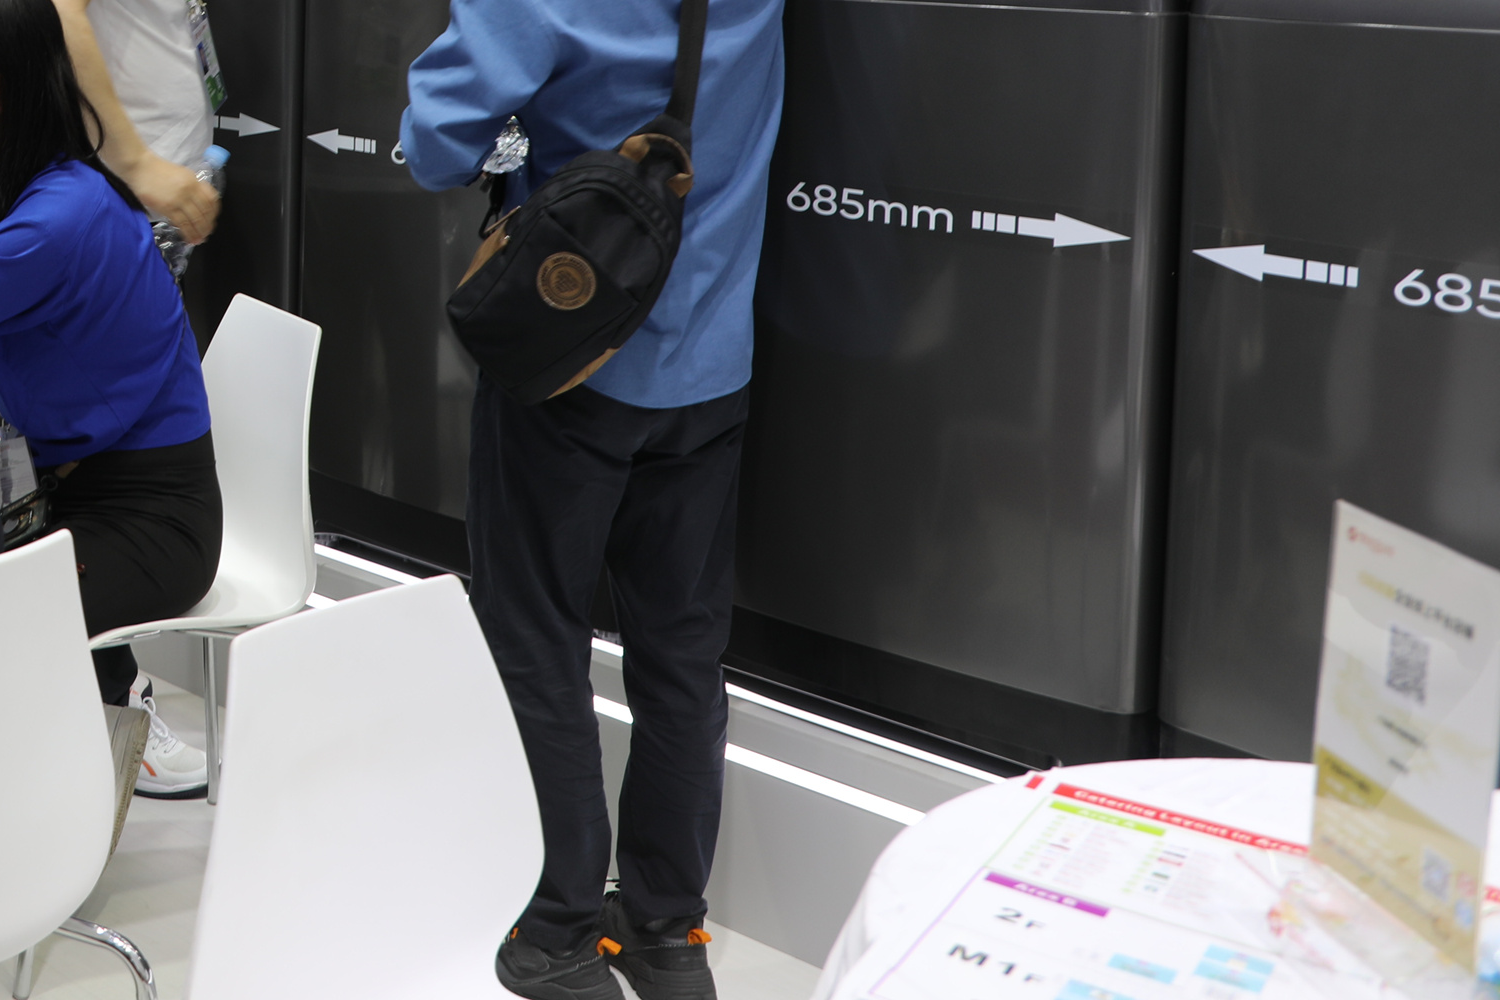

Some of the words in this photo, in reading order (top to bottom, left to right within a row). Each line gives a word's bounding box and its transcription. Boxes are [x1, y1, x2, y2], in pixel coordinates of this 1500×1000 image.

[786, 182, 953, 233] 685mm
[1394, 268, 1500, 319] 685
[1074, 790, 1158, 818] Catering
[1159, 812, 1228, 836] Layout
[1231, 829, 1251, 843] in
[996, 906, 1046, 929] 2F
[1012, 882, 1059, 902] Area
